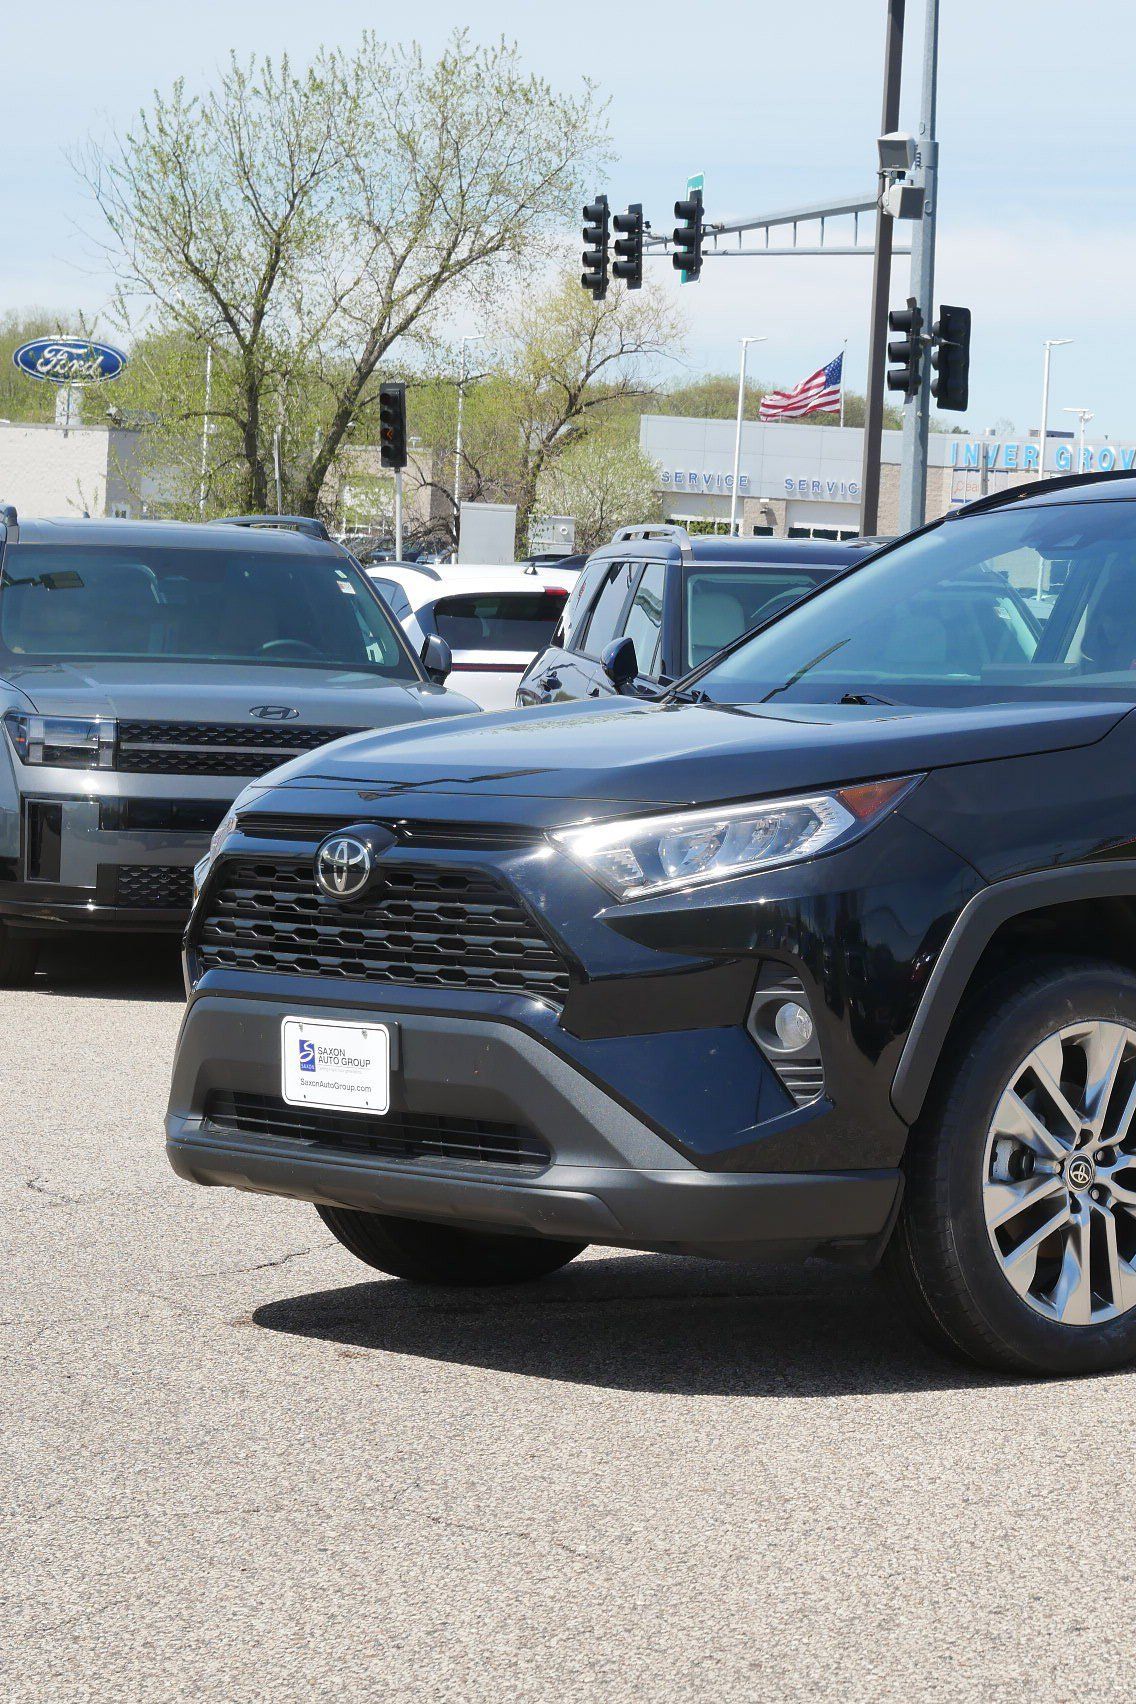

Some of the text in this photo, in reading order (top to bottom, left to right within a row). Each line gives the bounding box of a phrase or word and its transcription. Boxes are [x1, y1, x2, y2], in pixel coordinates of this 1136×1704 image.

[36, 345, 104, 377] Ford
[950, 440, 1040, 470] INVER
[660, 470, 749, 488] SERVICE
[784, 477, 864, 496] SERVIC
[317, 1046, 346, 1057] SAXON
[318, 1055, 371, 1068] AUTO GROUP
[300, 1078, 372, 1093] SaxonAutoGroup.com
